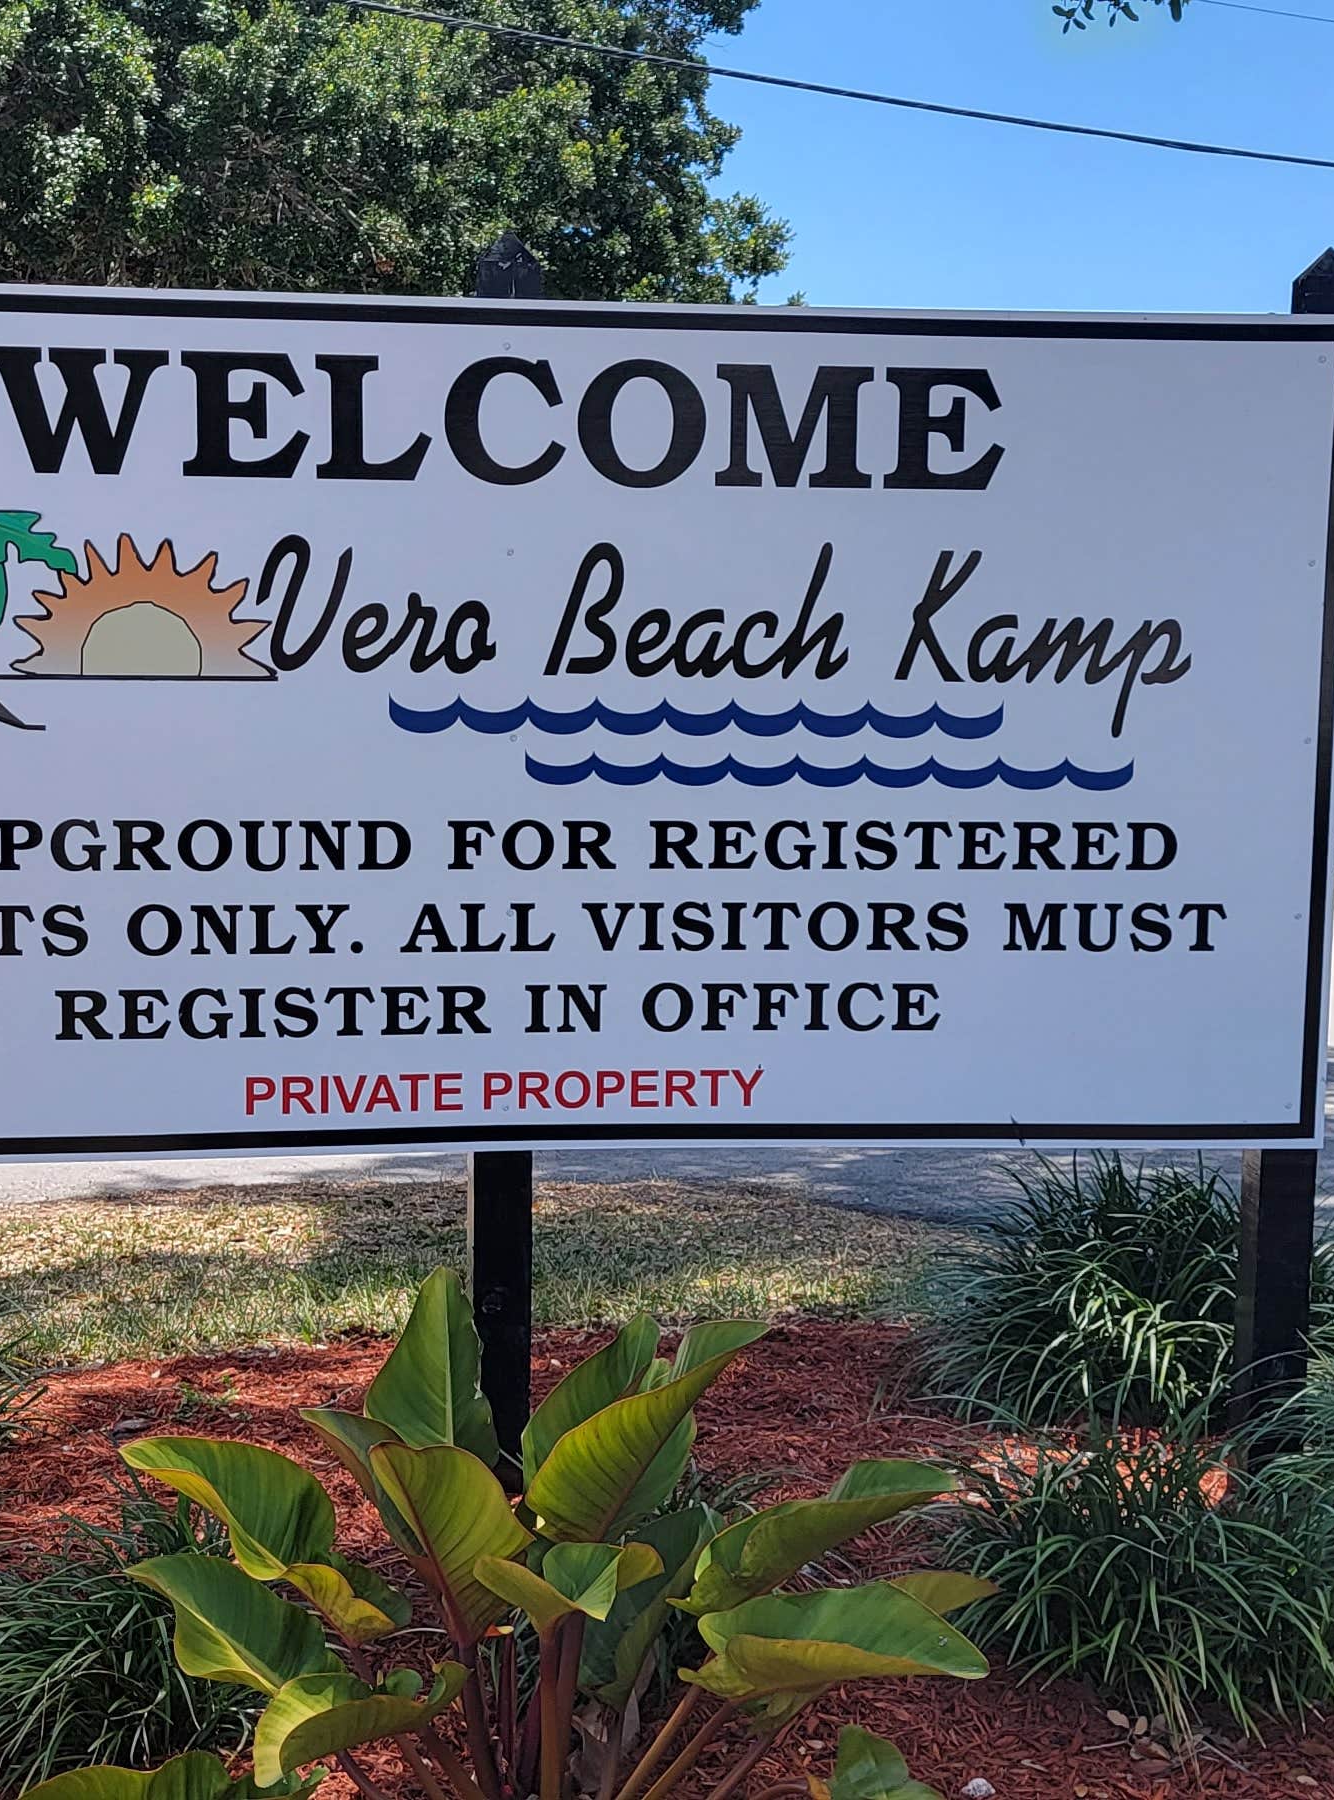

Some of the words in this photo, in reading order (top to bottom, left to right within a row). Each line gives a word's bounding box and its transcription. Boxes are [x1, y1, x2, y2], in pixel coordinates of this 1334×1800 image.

[255, 534, 496, 673] Vero
[543, 542, 848, 680] Beach
[885, 550, 1191, 739] Kamp
[448, 820, 616, 870] FOR
[649, 820, 1177, 870] REGISTERED
[127, 904, 363, 956] ONLY.
[400, 903, 556, 952] ALL
[582, 902, 968, 951] VISITORS
[1003, 903, 1227, 952] MUST
[55, 986, 491, 1040] REGISTER
[525, 984, 607, 1033] IN
[642, 983, 941, 1032] OFFICE
[246, 1073, 463, 1115] PRIVATE
[484, 1070, 763, 1109] PROPERTY
